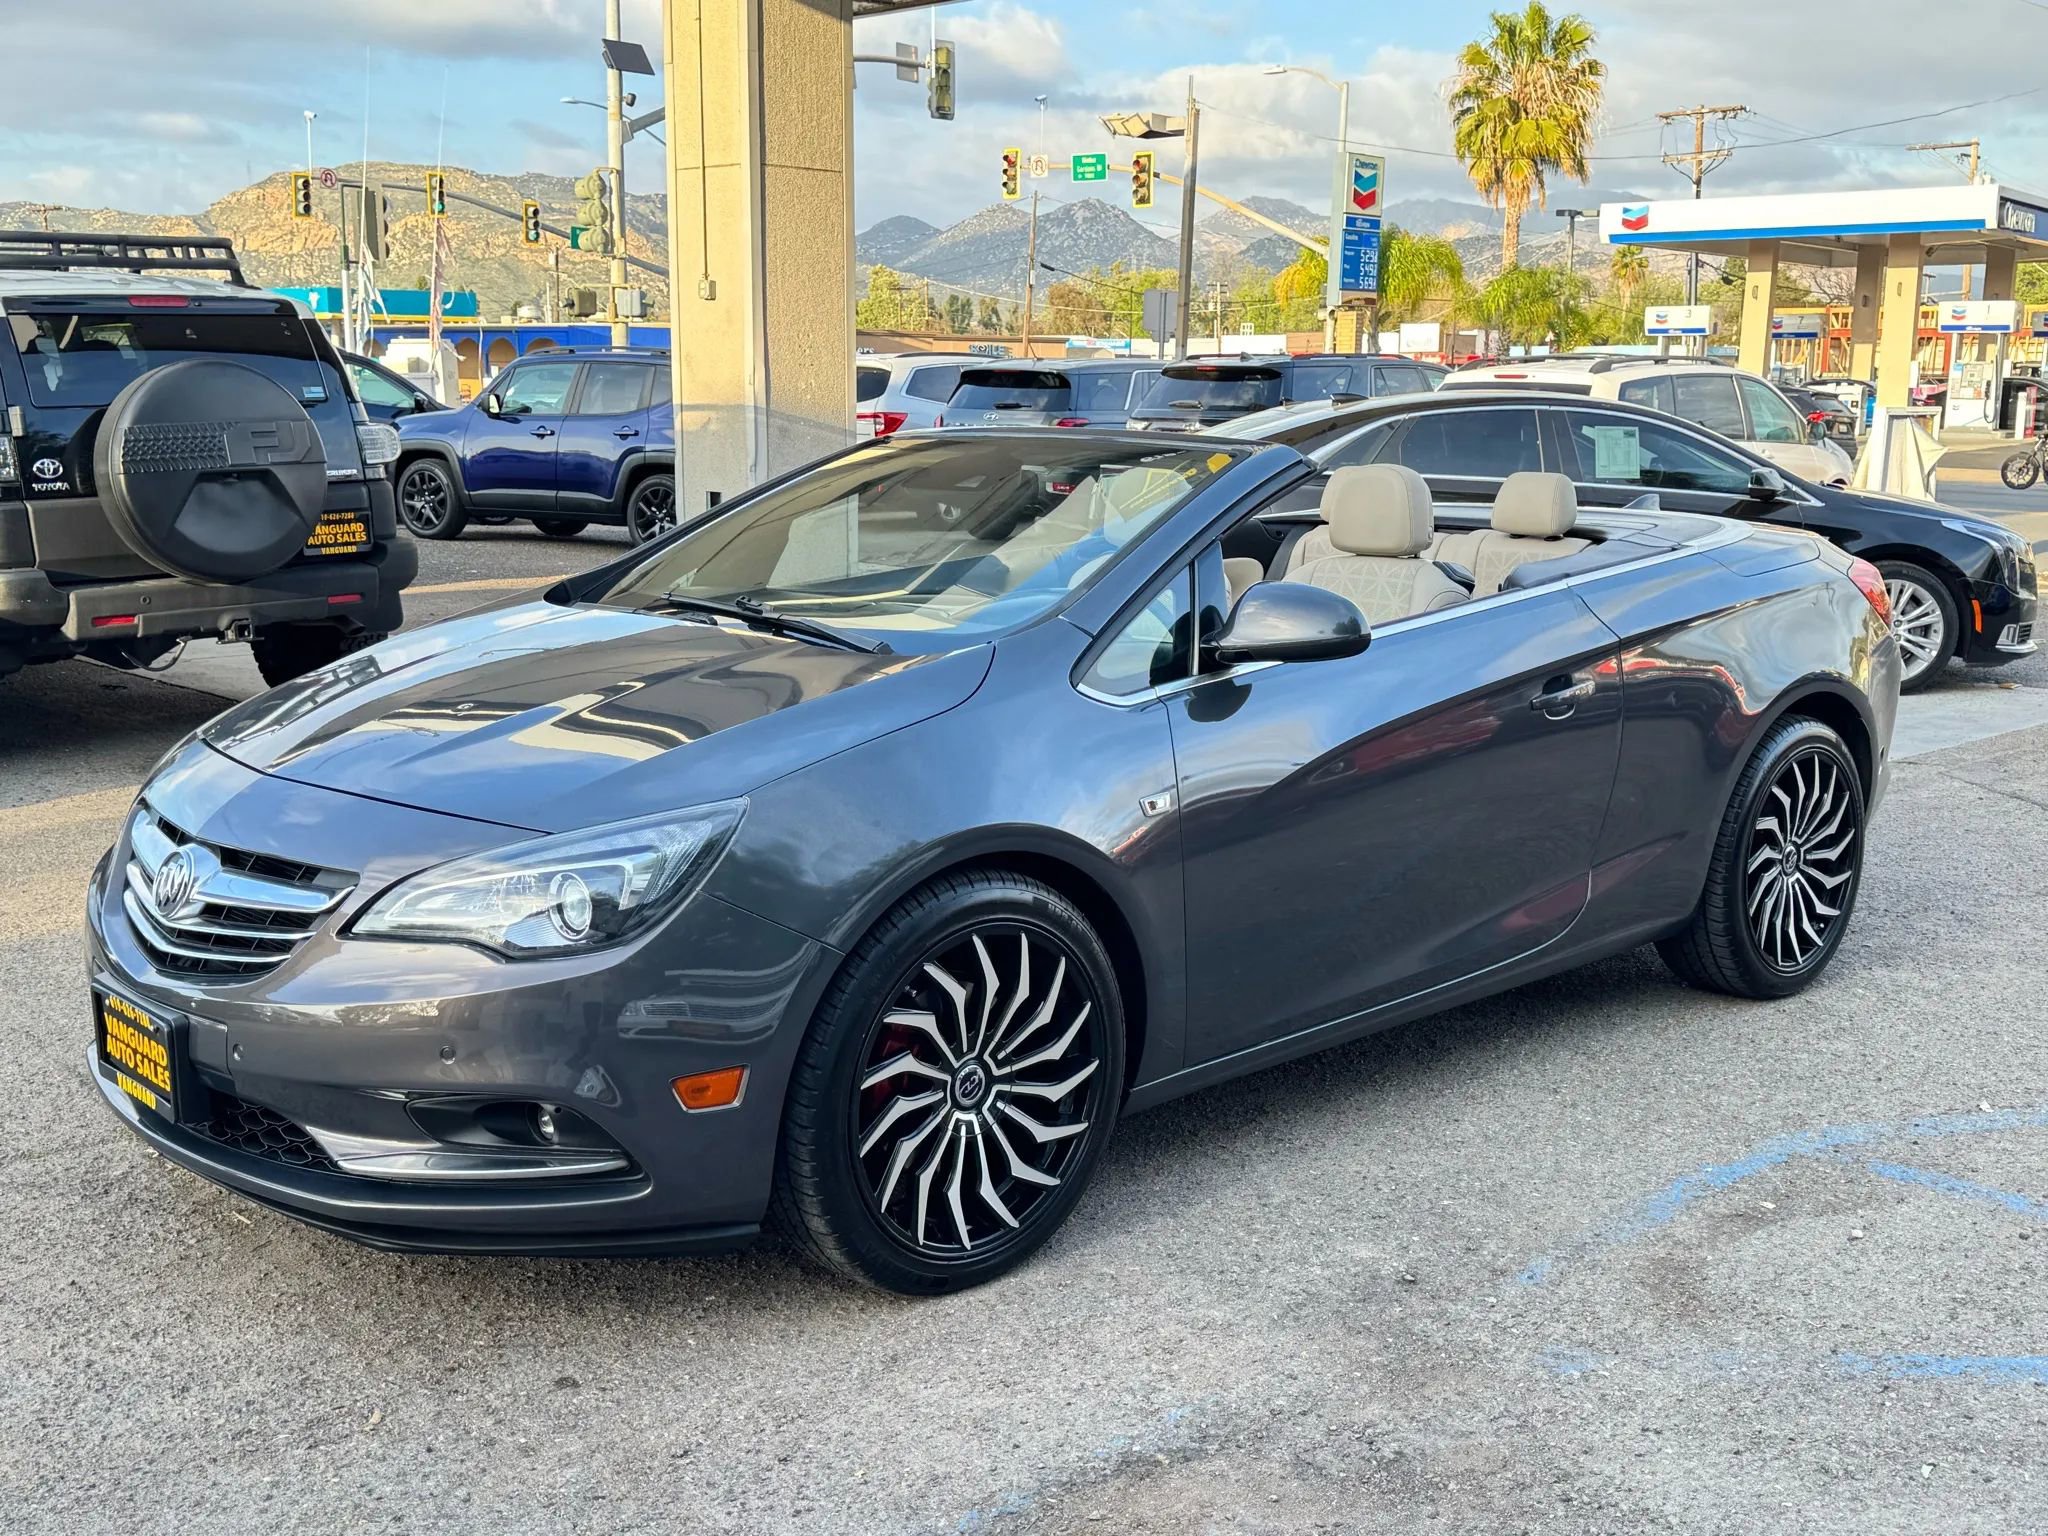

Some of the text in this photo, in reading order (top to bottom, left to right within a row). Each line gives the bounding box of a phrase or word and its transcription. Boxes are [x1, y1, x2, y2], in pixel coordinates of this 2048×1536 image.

[1797, 315, 1805, 325] 7
[31, 481, 71, 492] TOYOTA
[313, 522, 365, 536] ANGUARD
[307, 531, 367, 546] AUTO SALES
[321, 545, 357, 555] VANGUARD
[104, 1011, 168, 1067] VANGUARD
[106, 1033, 171, 1093] AUTO SALES
[116, 1070, 157, 1111] VANGUARD
